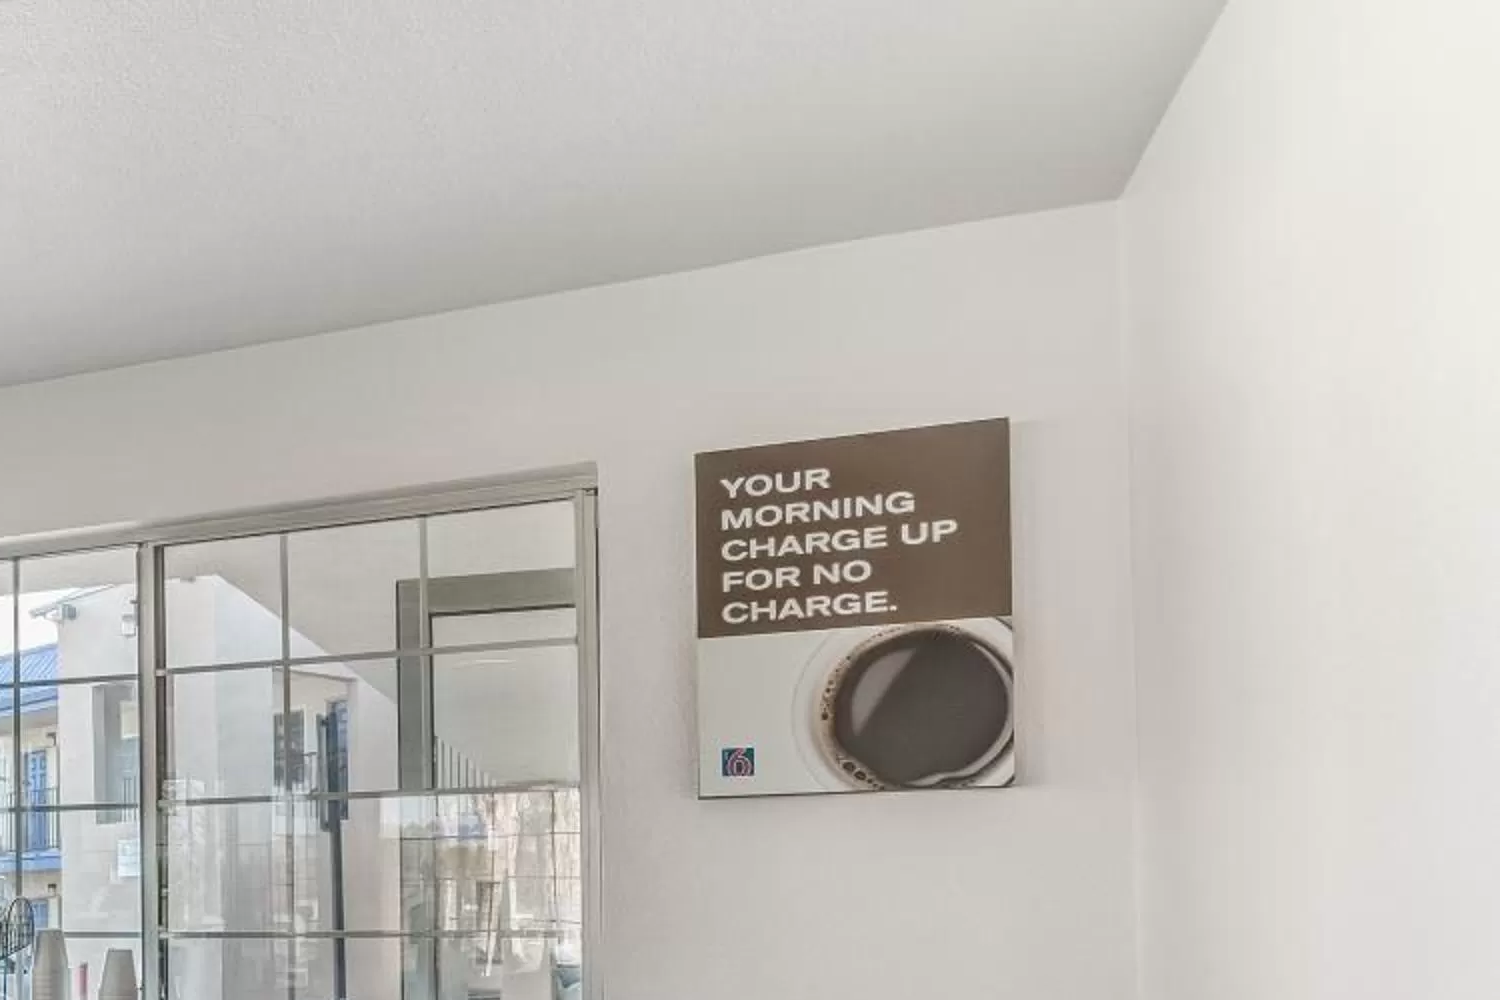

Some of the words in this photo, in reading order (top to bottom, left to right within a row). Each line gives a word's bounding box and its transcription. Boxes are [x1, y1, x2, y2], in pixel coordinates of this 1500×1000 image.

[720, 468, 831, 498] YOUR
[720, 491, 915, 531] MORNING
[721, 527, 888, 562] CHARGE
[901, 519, 959, 545] UP
[722, 566, 800, 593] FOR
[813, 560, 873, 585] NO
[721, 591, 897, 625] CHARGE.
